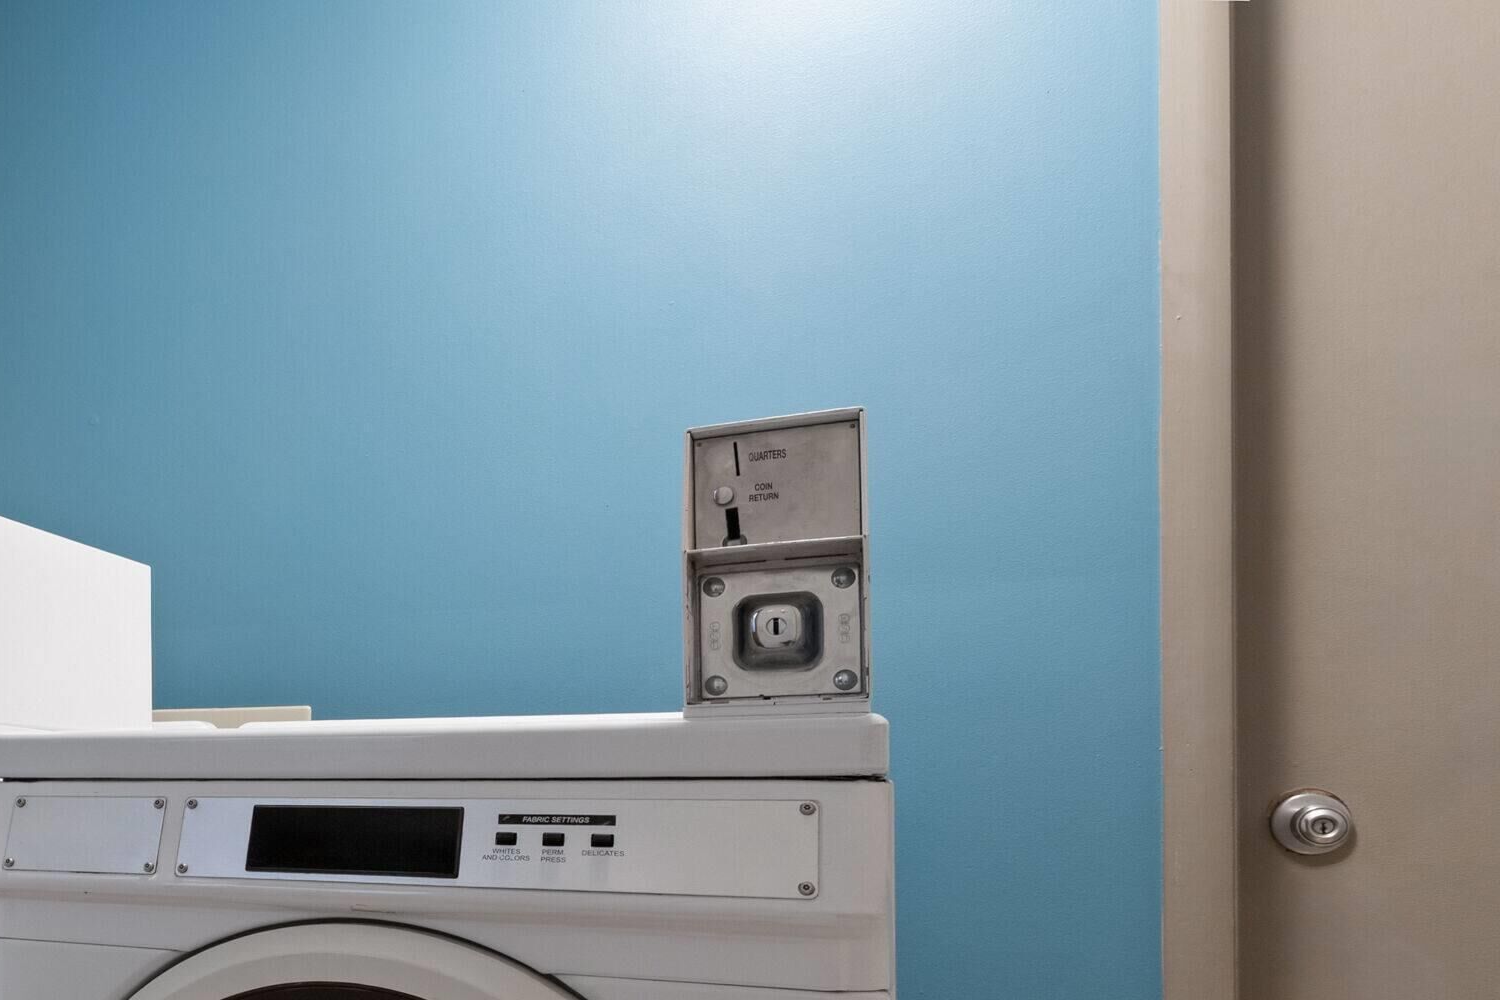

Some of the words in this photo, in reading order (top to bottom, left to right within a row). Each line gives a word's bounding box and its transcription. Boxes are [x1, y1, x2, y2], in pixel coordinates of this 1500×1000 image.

[748, 449, 787, 462] QUARTERS
[754, 482, 773, 491] COIN
[749, 493, 779, 502] RETURN
[551, 816, 591, 824] SETTINGS
[581, 849, 625, 857] DELICATES
